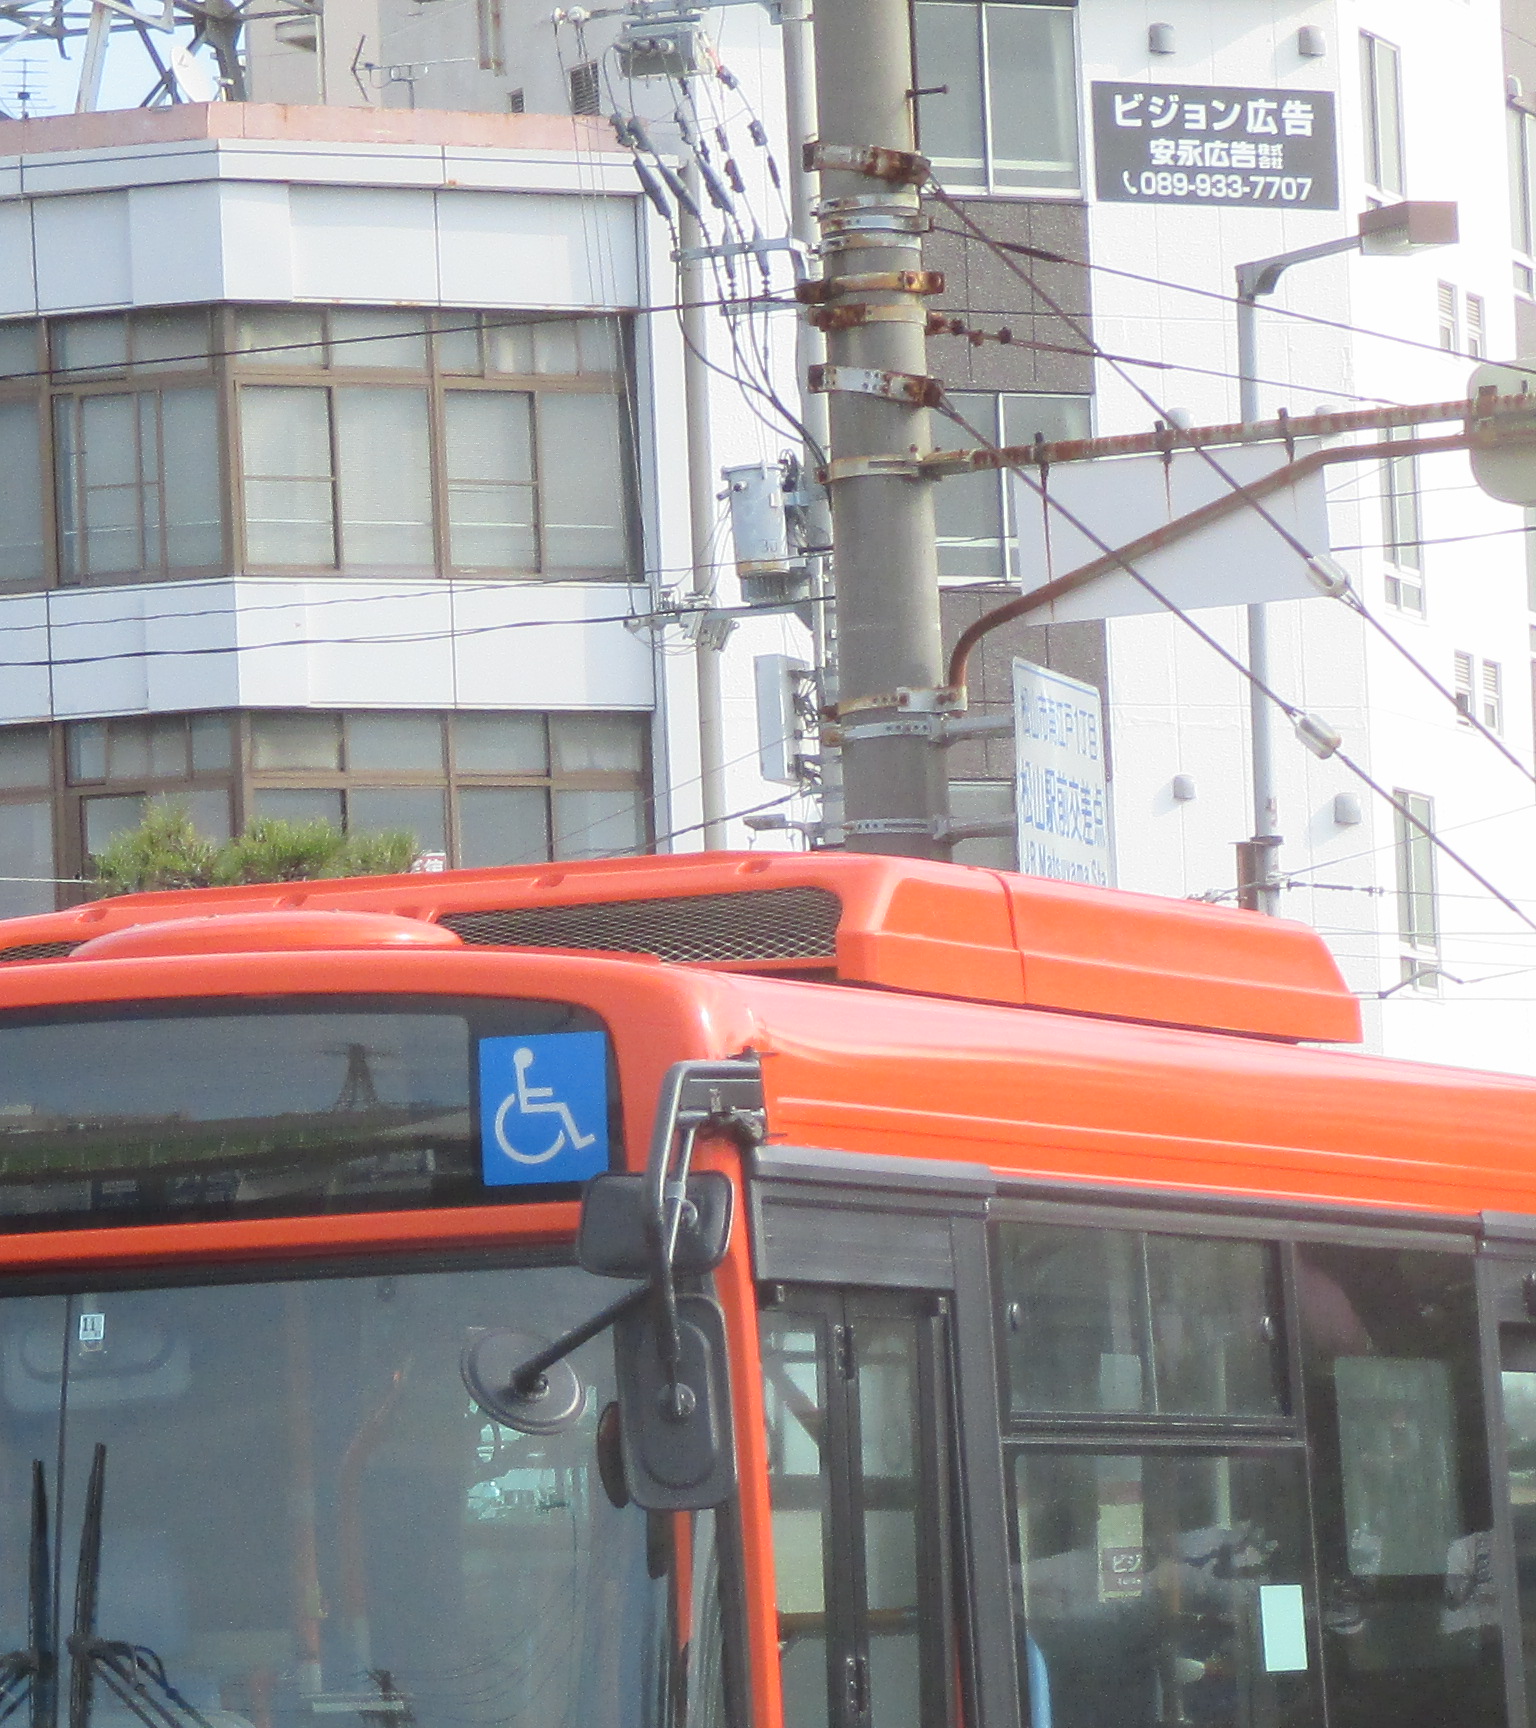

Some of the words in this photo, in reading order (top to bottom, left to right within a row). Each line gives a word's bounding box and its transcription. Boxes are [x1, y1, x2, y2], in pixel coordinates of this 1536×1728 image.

[1114, 93, 1314, 137] ビジョン広告
[1140, 171, 1313, 201] 089-933-7707
